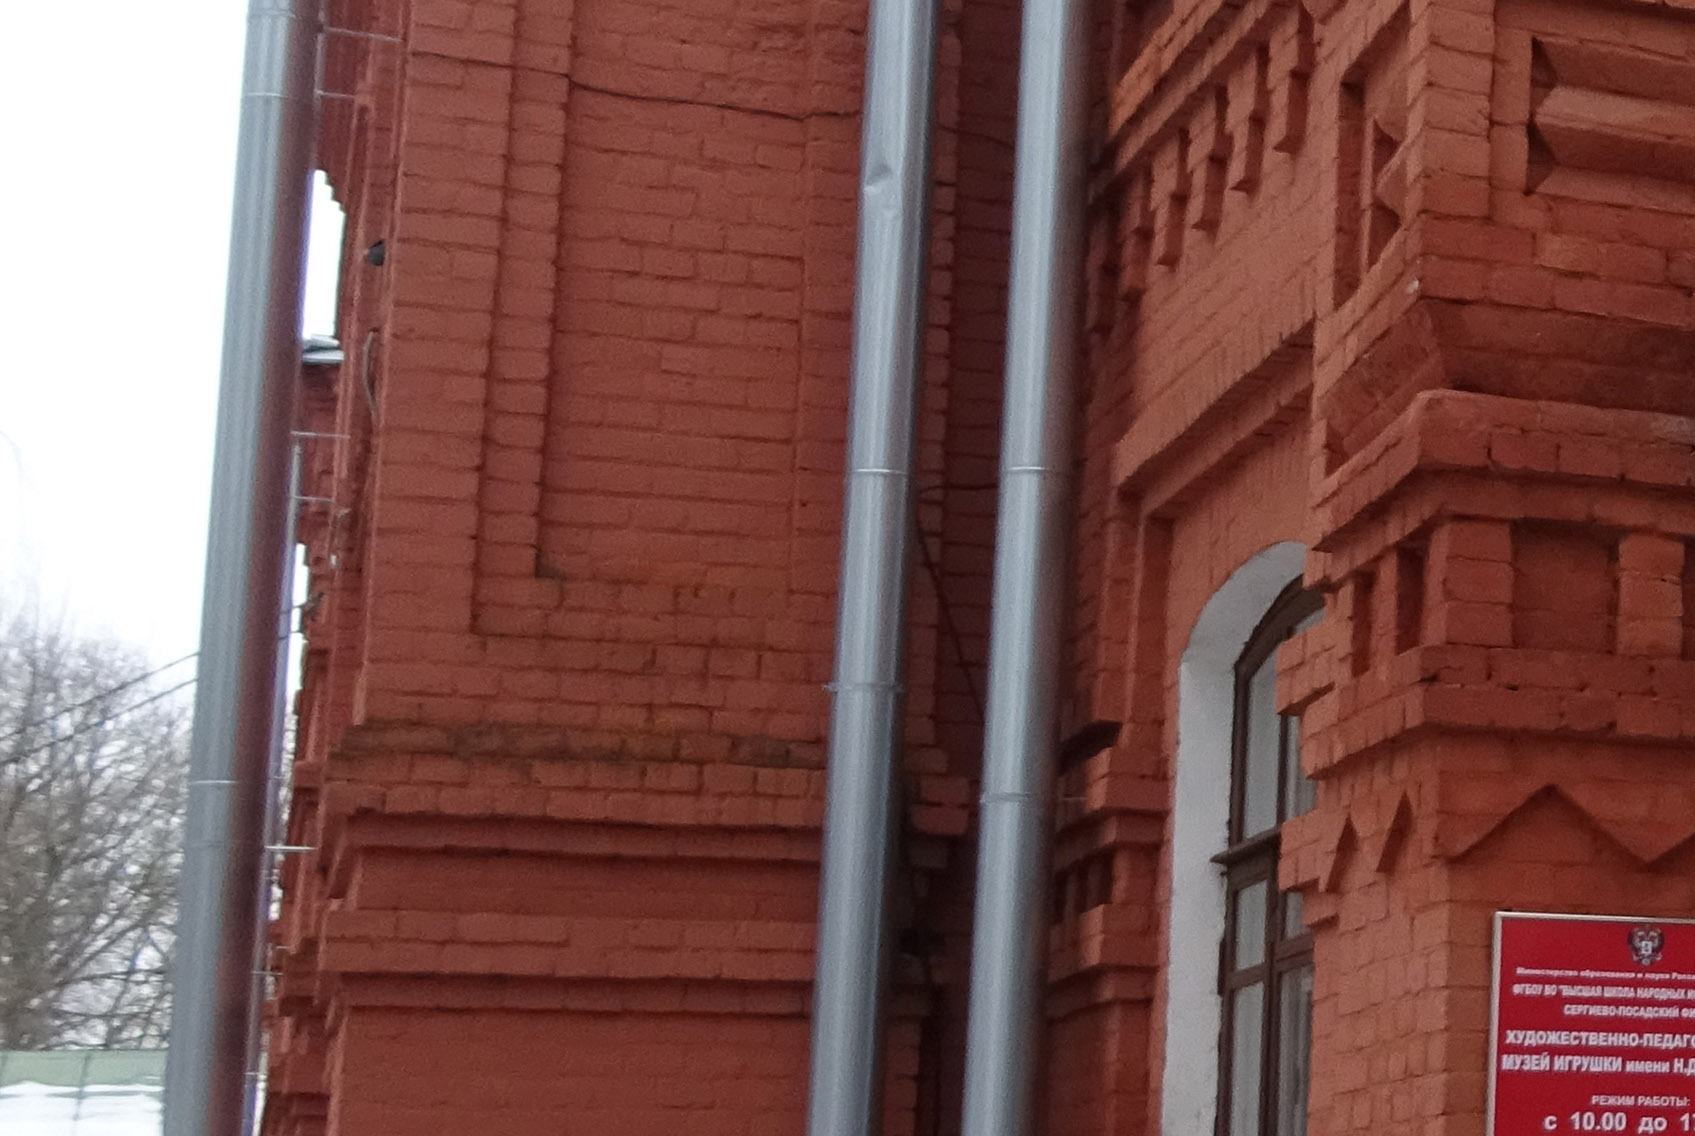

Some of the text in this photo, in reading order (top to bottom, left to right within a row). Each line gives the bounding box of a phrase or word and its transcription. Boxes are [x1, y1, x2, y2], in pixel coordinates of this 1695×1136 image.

[1516, 966, 1578, 977] Министерство
[1513, 984, 1543, 996] ФГБОУ
[1544, 985, 1557, 996] ВО
[1603, 986, 1635, 998] ШКОЛА
[1637, 987, 1686, 1001] НАРОДНЫХ
[1564, 1004, 1680, 1019] СЕРГИЕВО-ПОСАДСКИЙ
[1501, 1052, 1550, 1071] МУЗЕЙ
[1553, 1055, 1622, 1072] ИГРУШКИ
[1626, 1061, 1670, 1073] имени
[1591, 1094, 1691, 1107] РЕЖИМ РАБОТЫ:
[1543, 1115, 1558, 1131] с
[1570, 1111, 1627, 1131] 10.00
[1637, 1116, 1668, 1134] до
